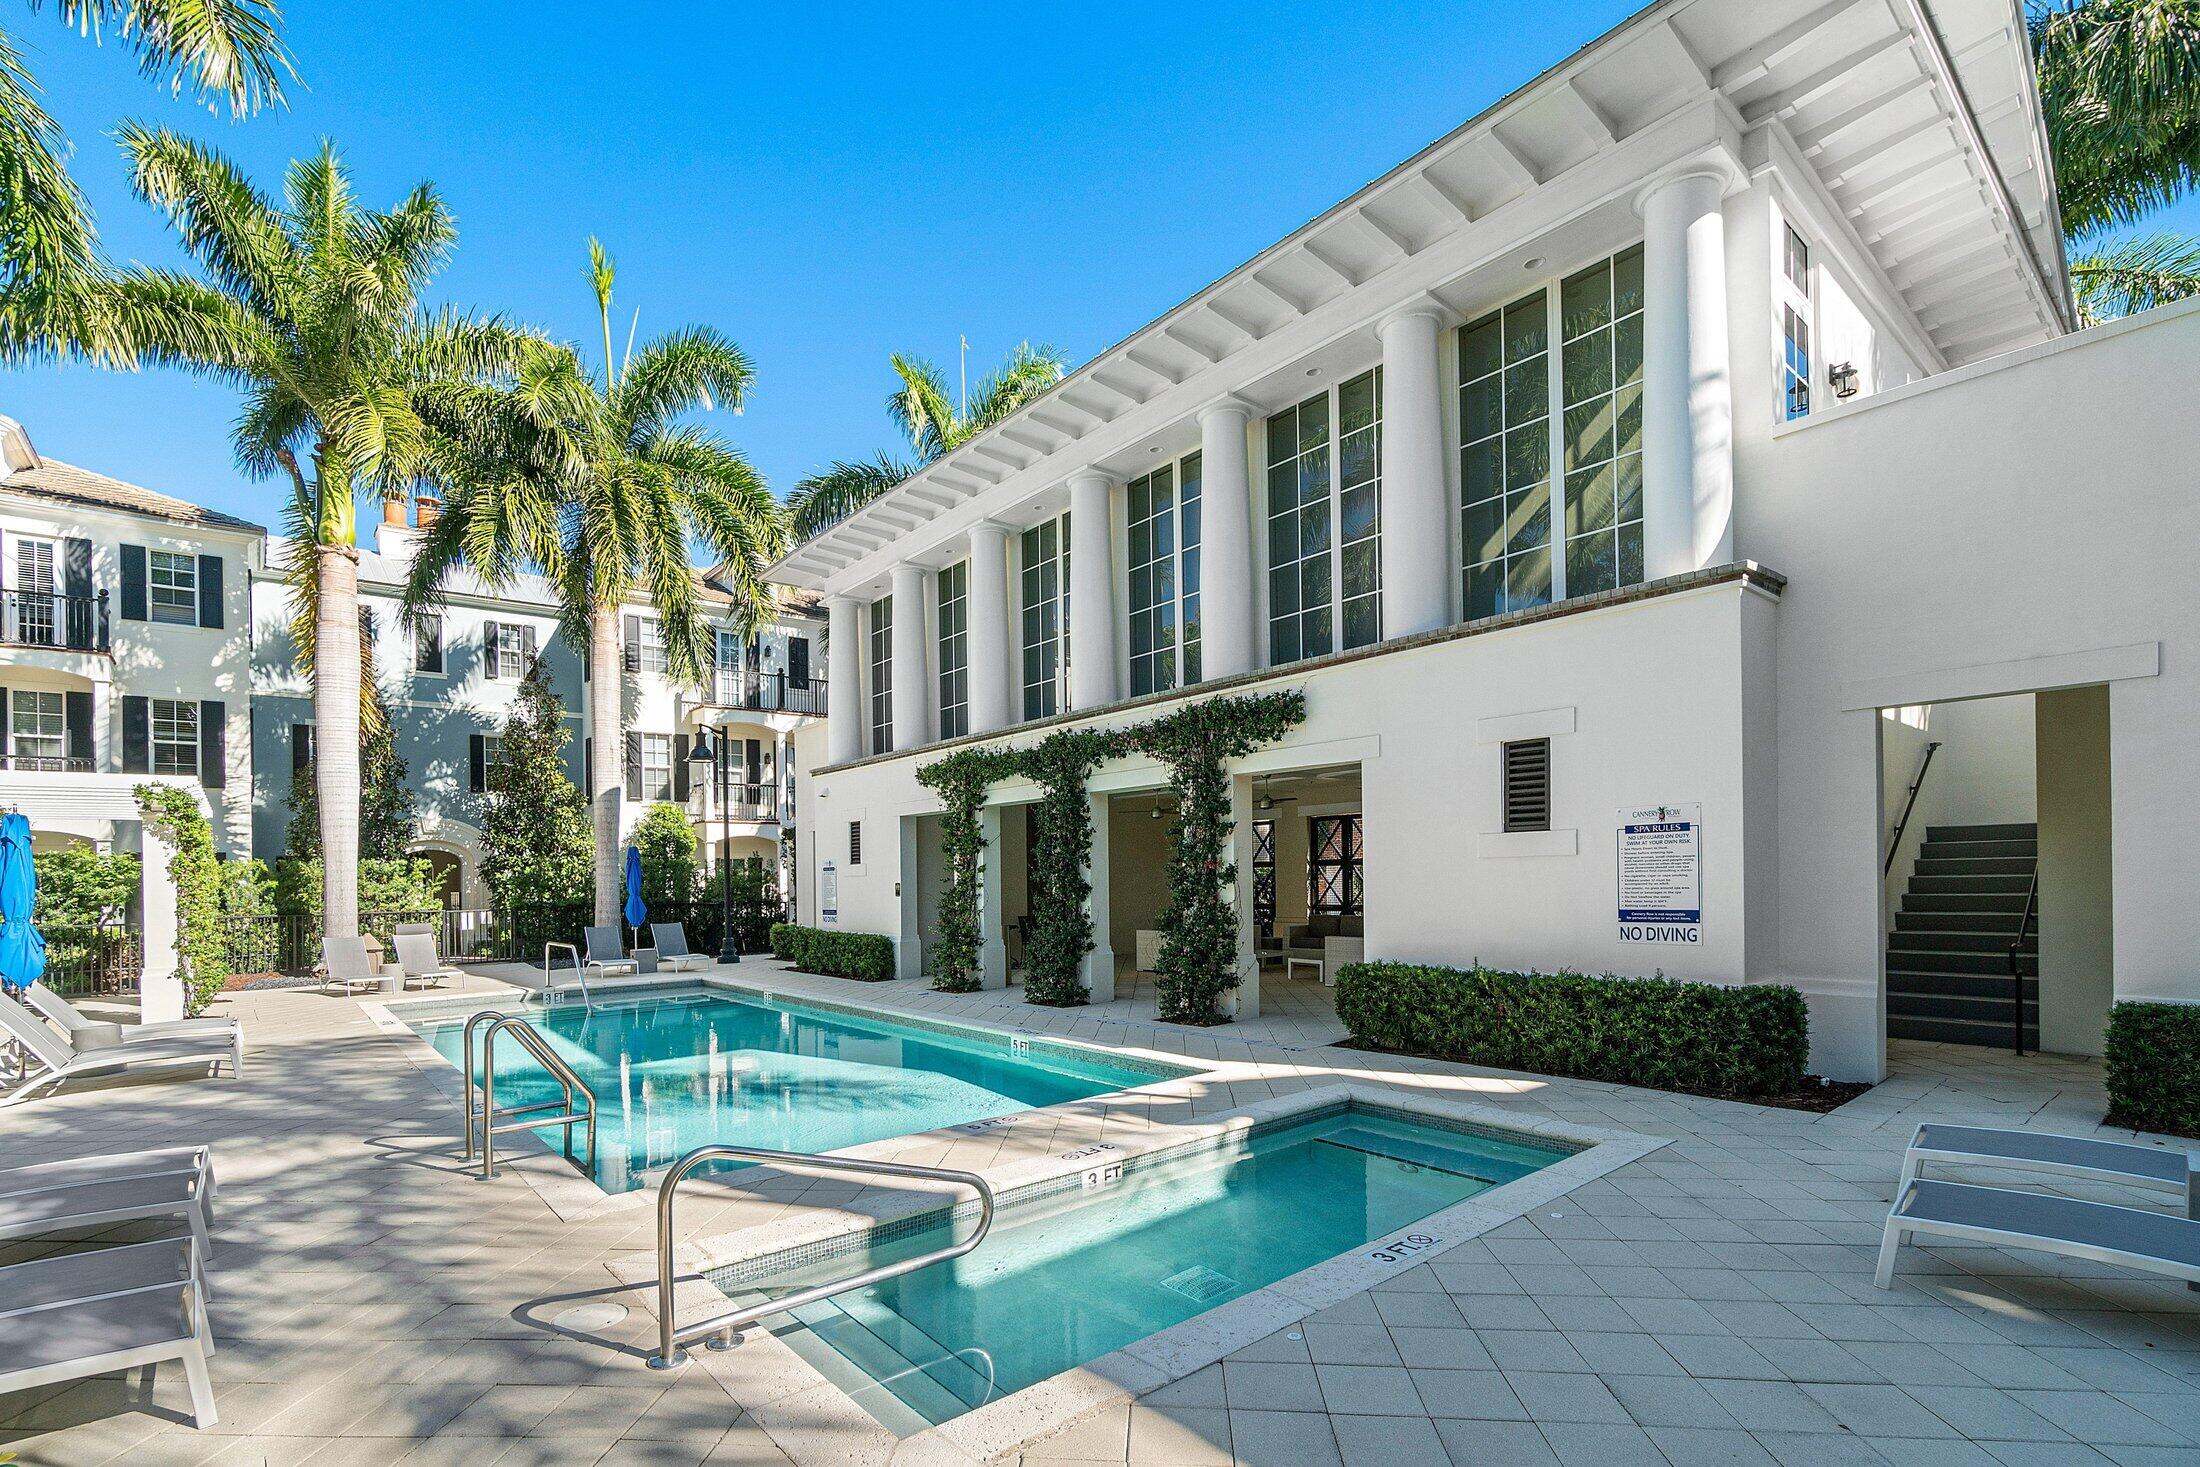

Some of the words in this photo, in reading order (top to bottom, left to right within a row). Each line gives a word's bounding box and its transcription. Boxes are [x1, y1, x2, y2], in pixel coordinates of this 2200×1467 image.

[1620, 926, 1642, 941] NO
[1646, 927, 1697, 942] DIVING
[1013, 1040, 1018, 1049] 5
[1020, 1041, 1028, 1050] FT
[1088, 1172, 1097, 1184] 3
[1372, 1252, 1396, 1262] 3
